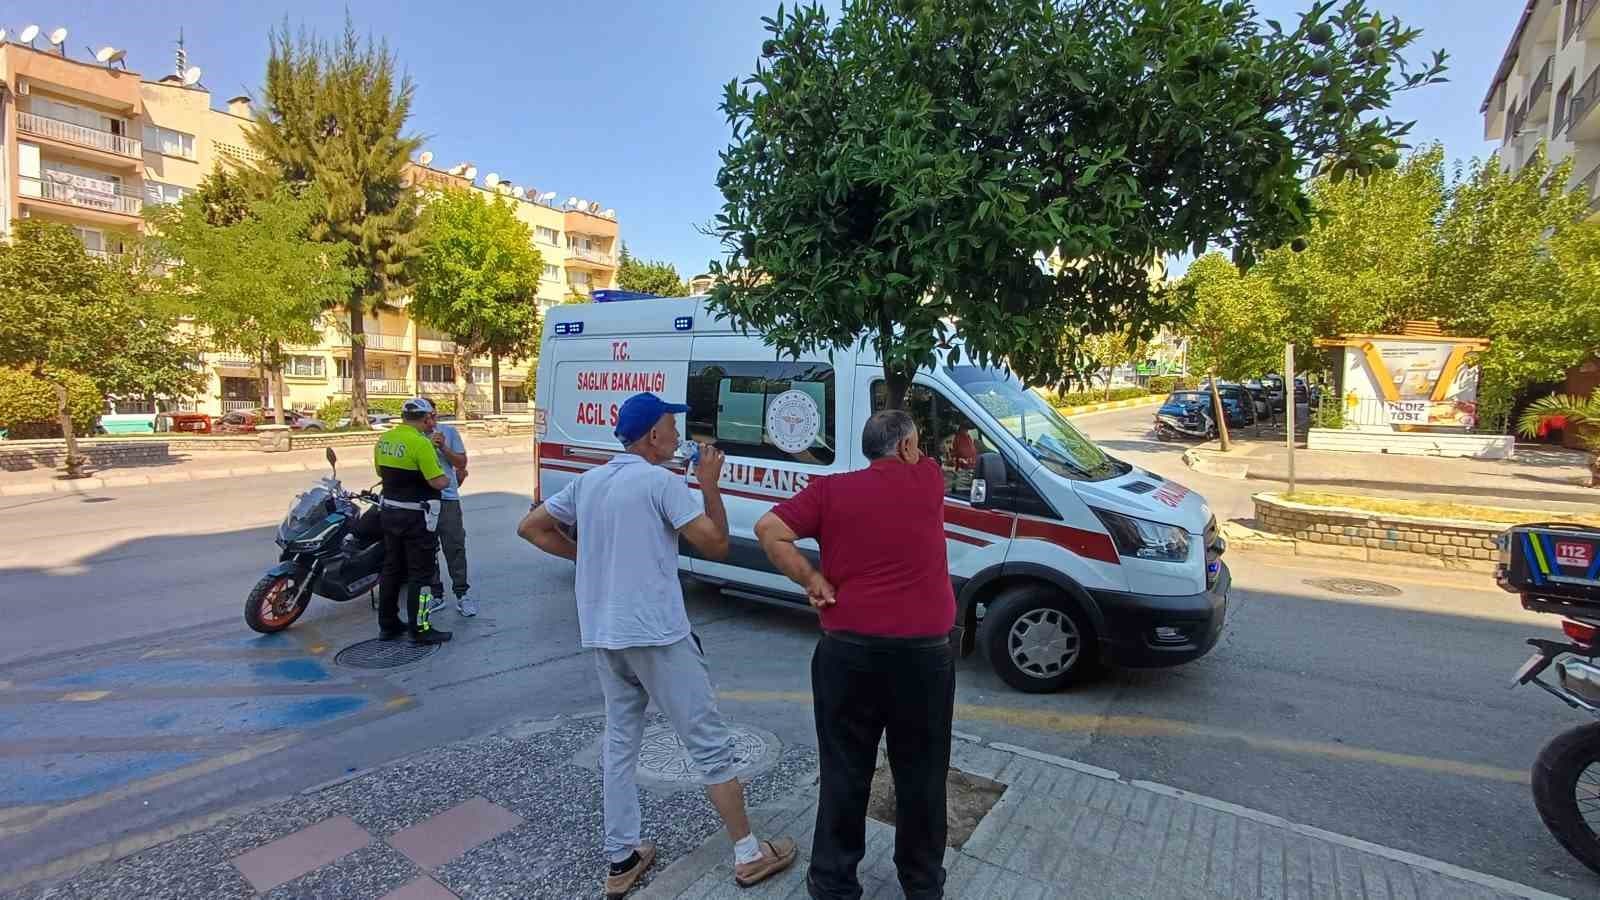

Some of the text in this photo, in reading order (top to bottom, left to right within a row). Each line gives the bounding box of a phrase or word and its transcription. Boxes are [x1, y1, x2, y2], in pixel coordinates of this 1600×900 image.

[612, 341, 631, 360] T.C.
[686, 460, 810, 493] ABULANS
[1560, 544, 1586, 558] 112
